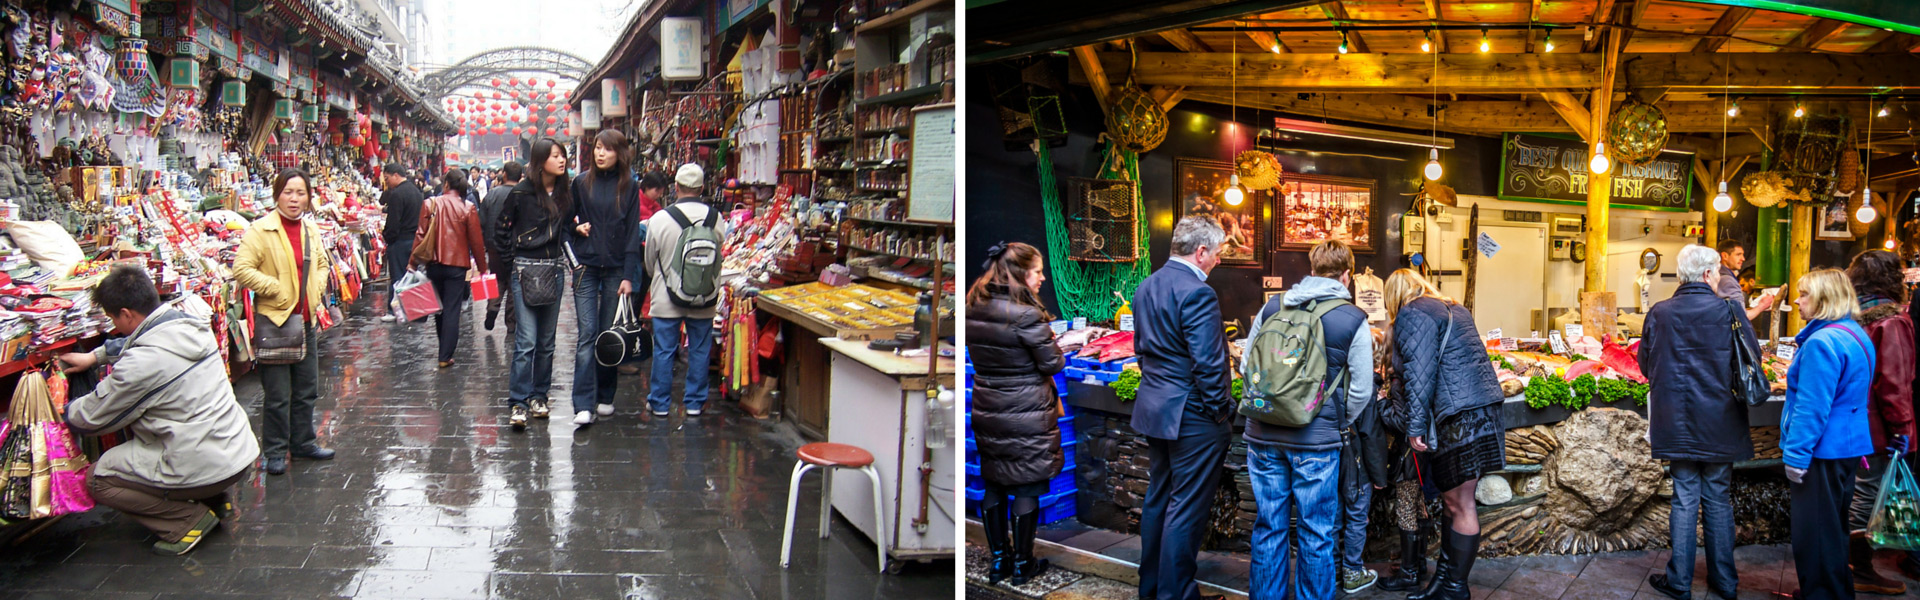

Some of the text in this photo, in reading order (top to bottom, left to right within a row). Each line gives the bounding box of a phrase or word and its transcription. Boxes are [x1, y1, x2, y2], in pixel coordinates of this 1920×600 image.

[1519, 146, 1558, 169] BEST
[1561, 149, 1619, 176] QUAY
[1613, 177, 1644, 199] FISH
